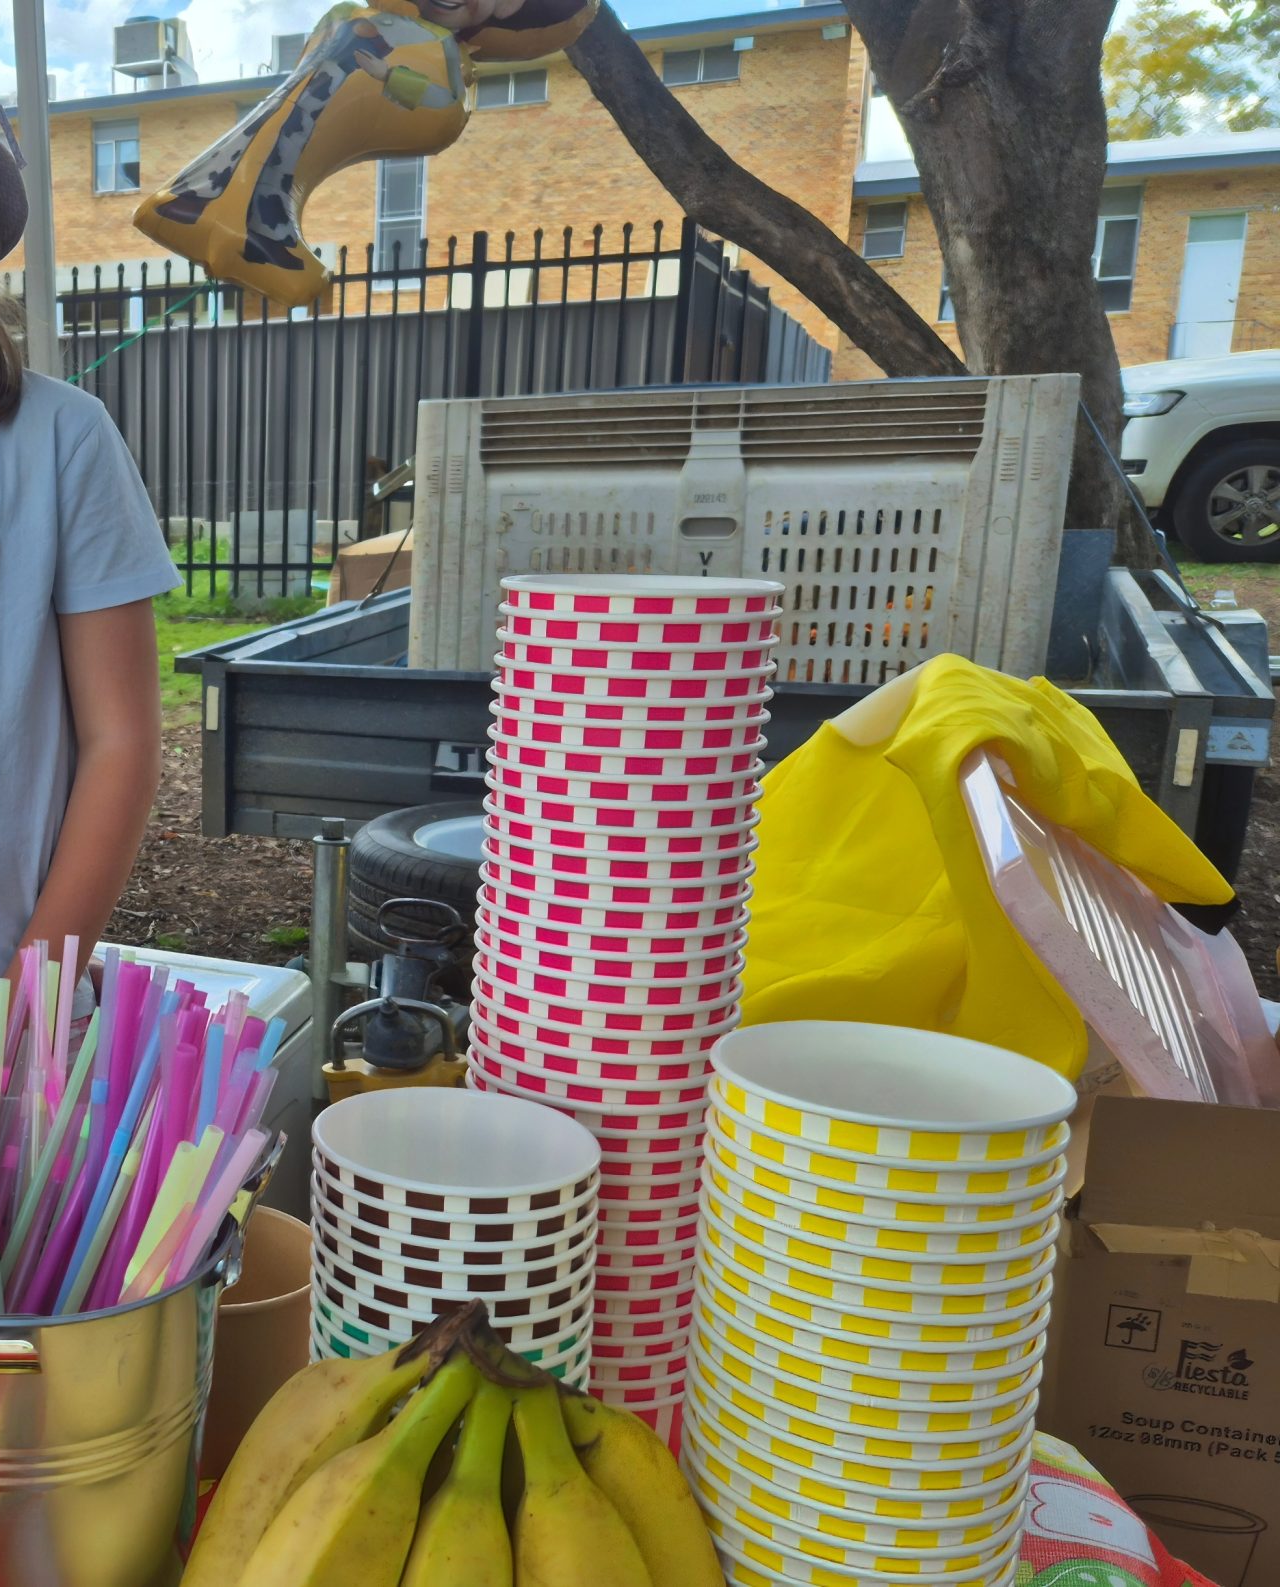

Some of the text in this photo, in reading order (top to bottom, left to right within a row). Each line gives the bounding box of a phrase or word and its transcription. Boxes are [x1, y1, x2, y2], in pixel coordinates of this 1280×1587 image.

[1175, 1339, 1249, 1387] Fiesta
[1174, 1381, 1249, 1401] RECYCLABLE
[1121, 1411, 1175, 1433] Soup
[1088, 1425, 1135, 1443] 12oz
[1207, 1441, 1268, 1463] (Pack
